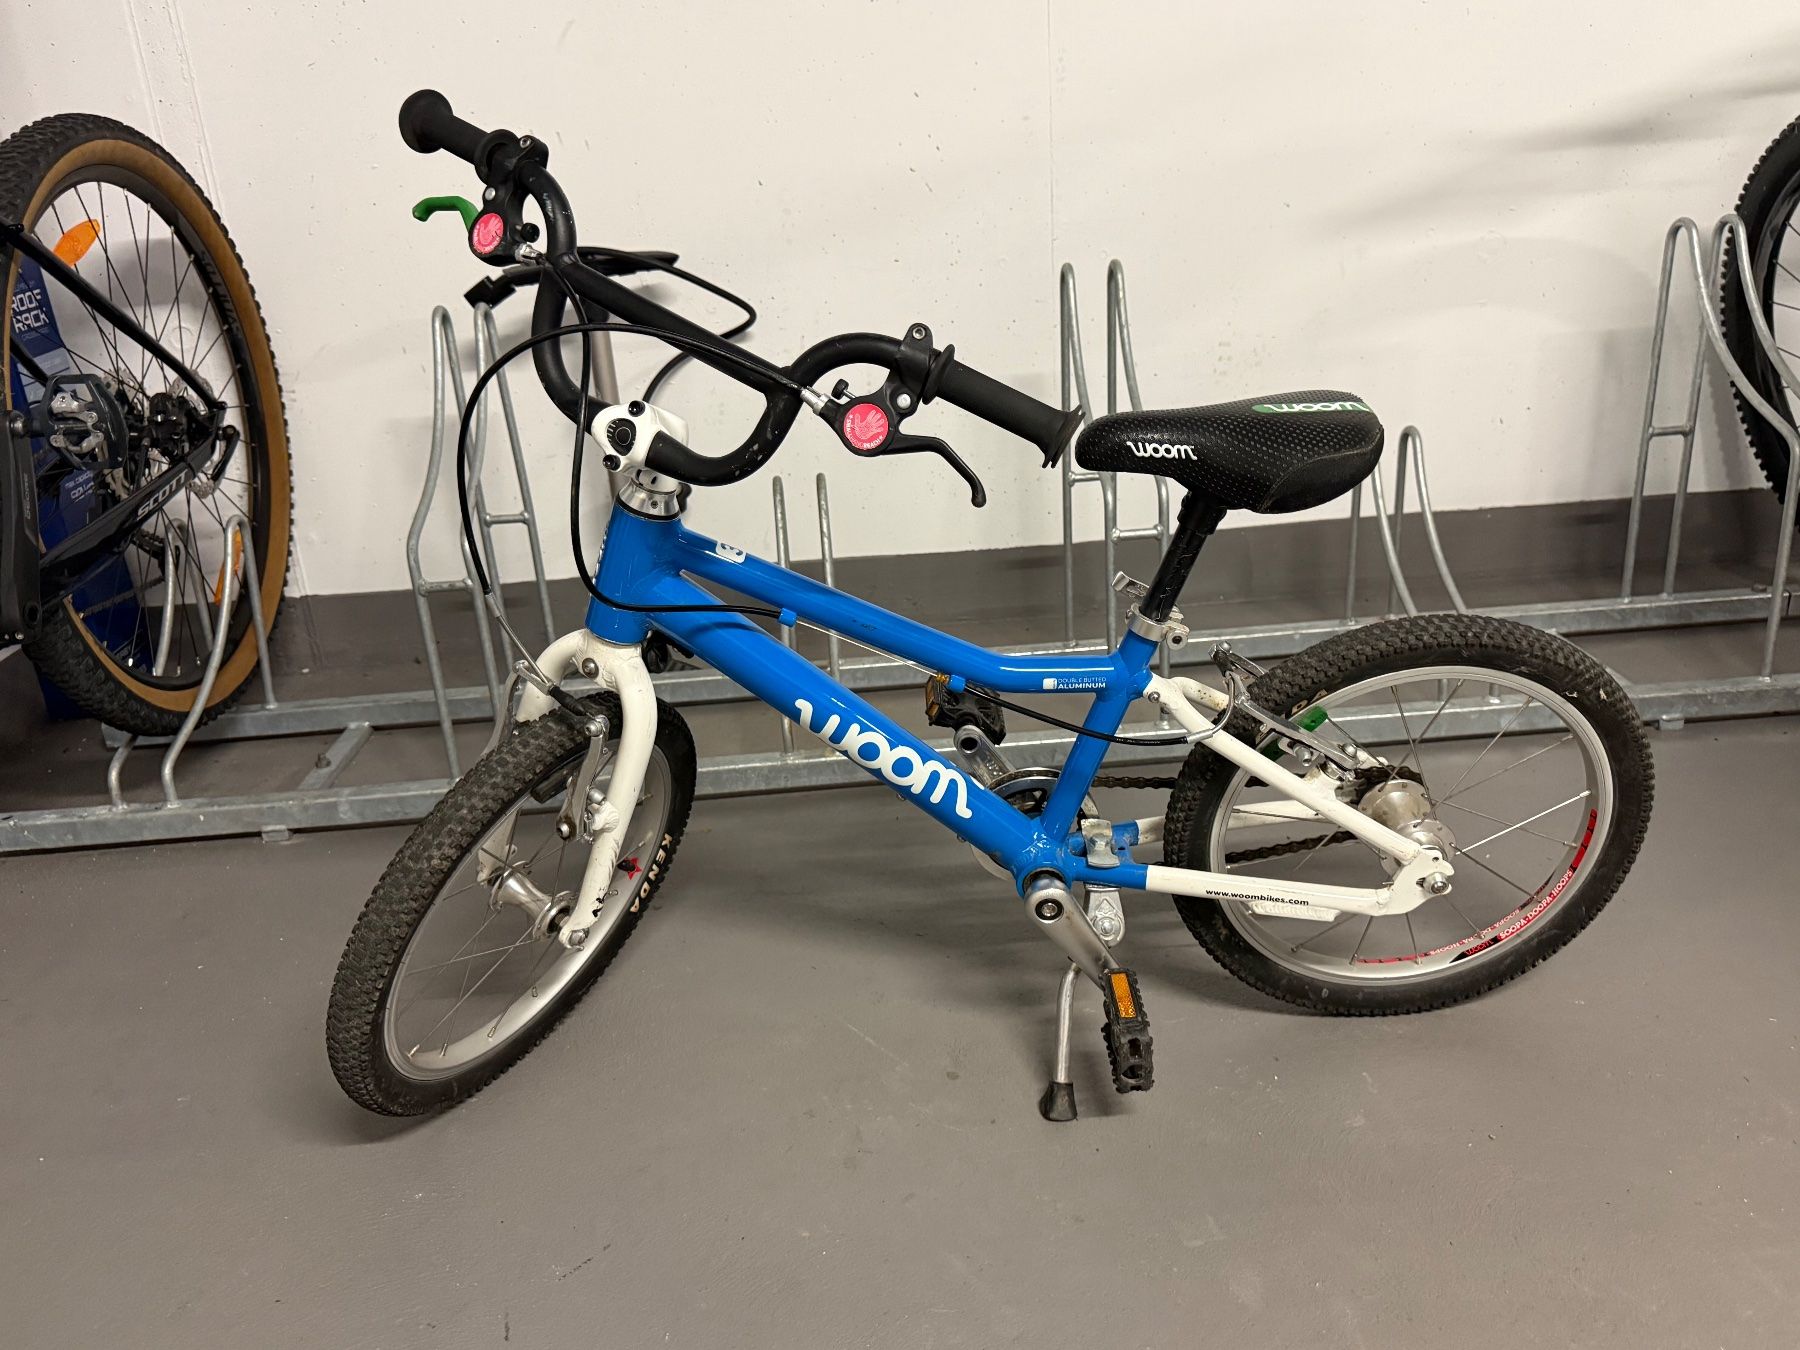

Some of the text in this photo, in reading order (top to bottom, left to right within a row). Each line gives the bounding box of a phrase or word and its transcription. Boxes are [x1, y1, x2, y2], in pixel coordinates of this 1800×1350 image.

[1263, 402, 1371, 412] woom
[1126, 441, 1198, 460] woom
[136, 469, 188, 520] SCOTT
[794, 698, 973, 819] woom
[630, 833, 673, 913] KENDA
[1205, 888, 1310, 906] www.woombikes.com
